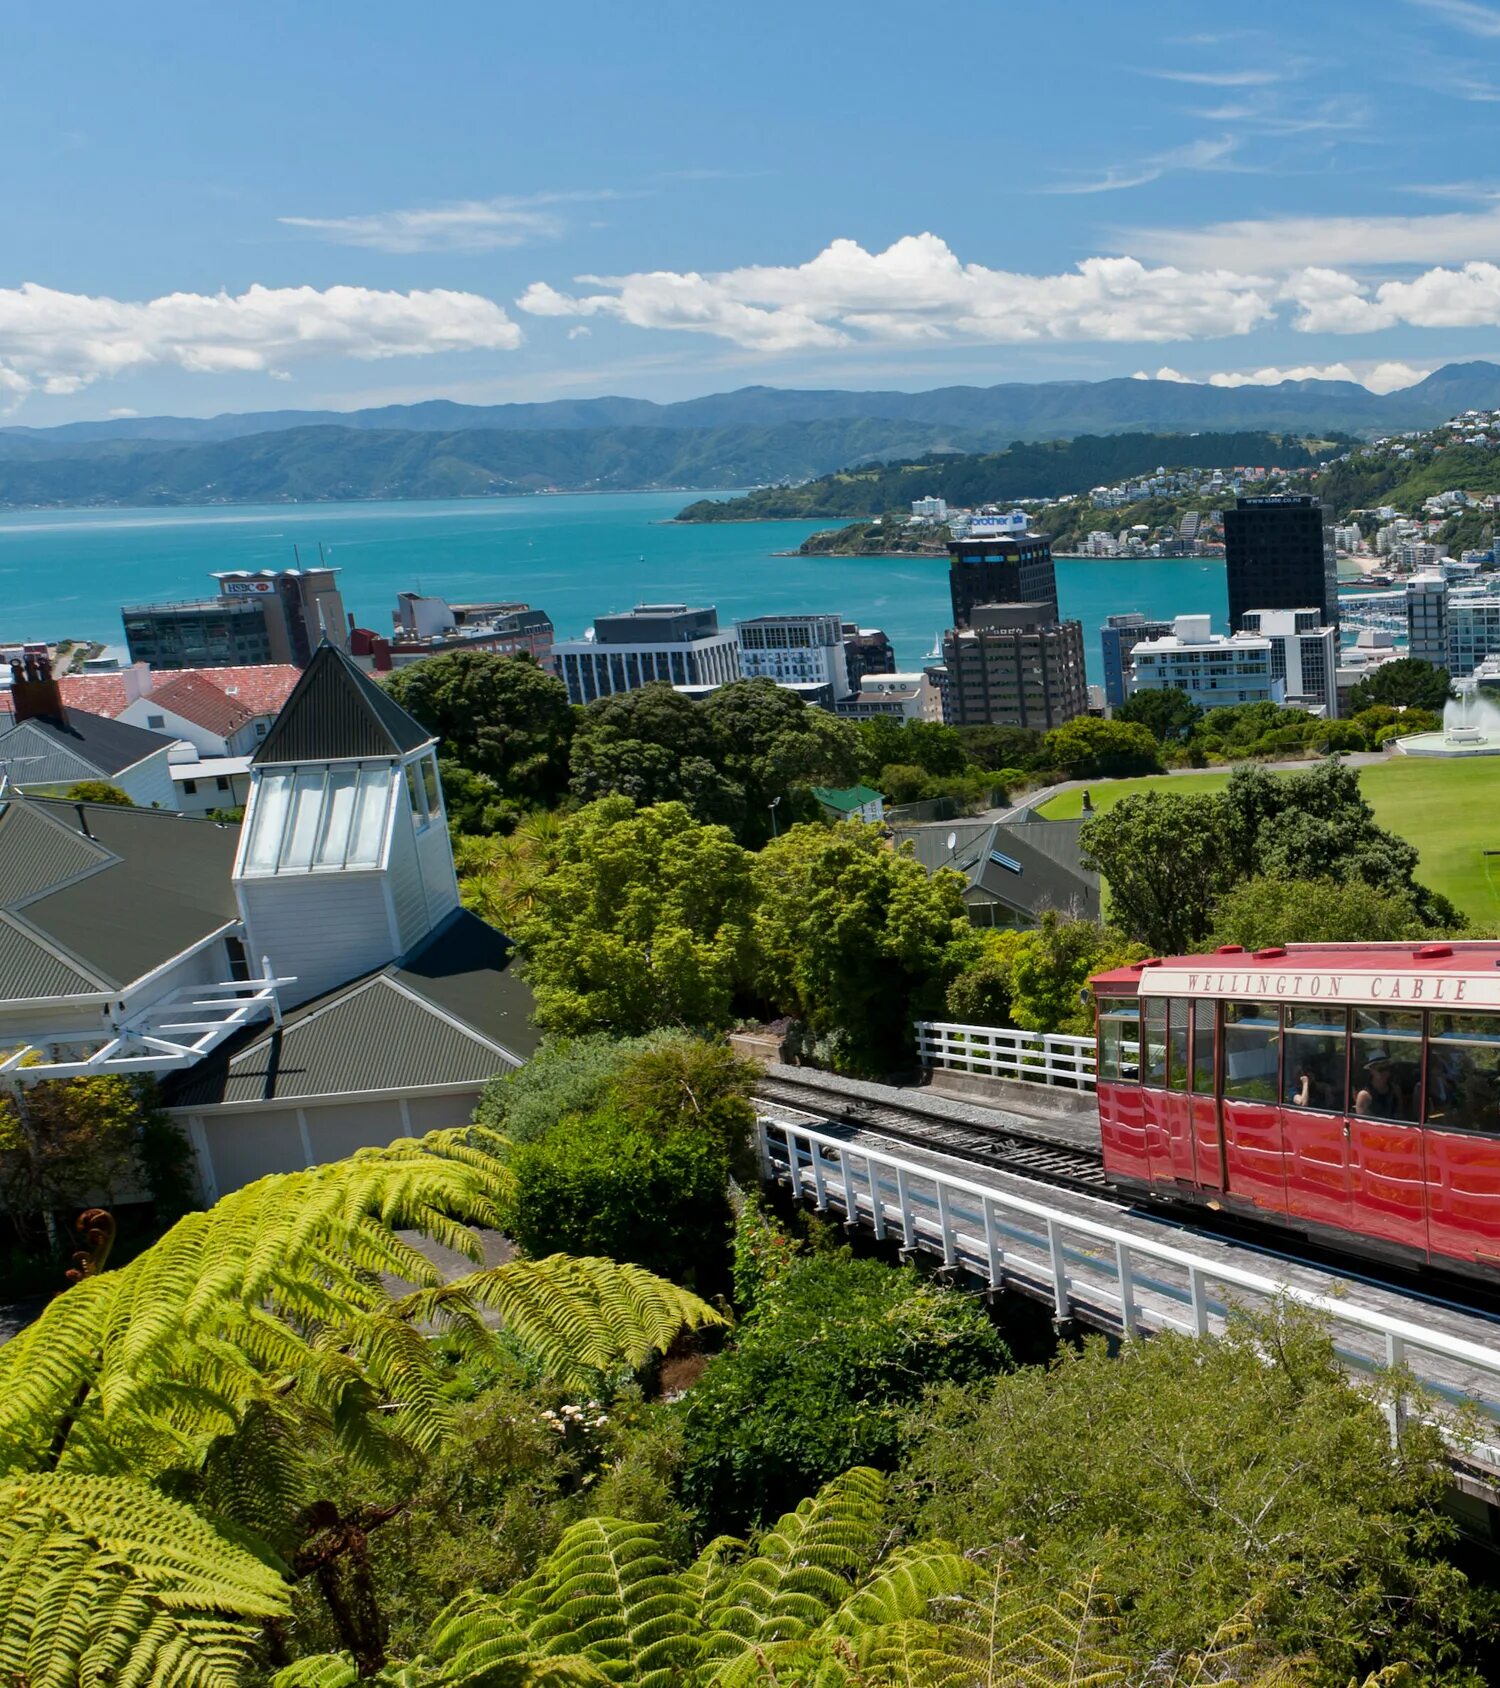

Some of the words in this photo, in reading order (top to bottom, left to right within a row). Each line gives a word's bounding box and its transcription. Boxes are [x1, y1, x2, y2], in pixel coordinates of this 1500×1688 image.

[970, 516, 1008, 525] brother
[228, 583, 255, 592] HSBC
[1188, 975, 1343, 996] WELLINGTON
[1371, 977, 1467, 1000] CABLE
